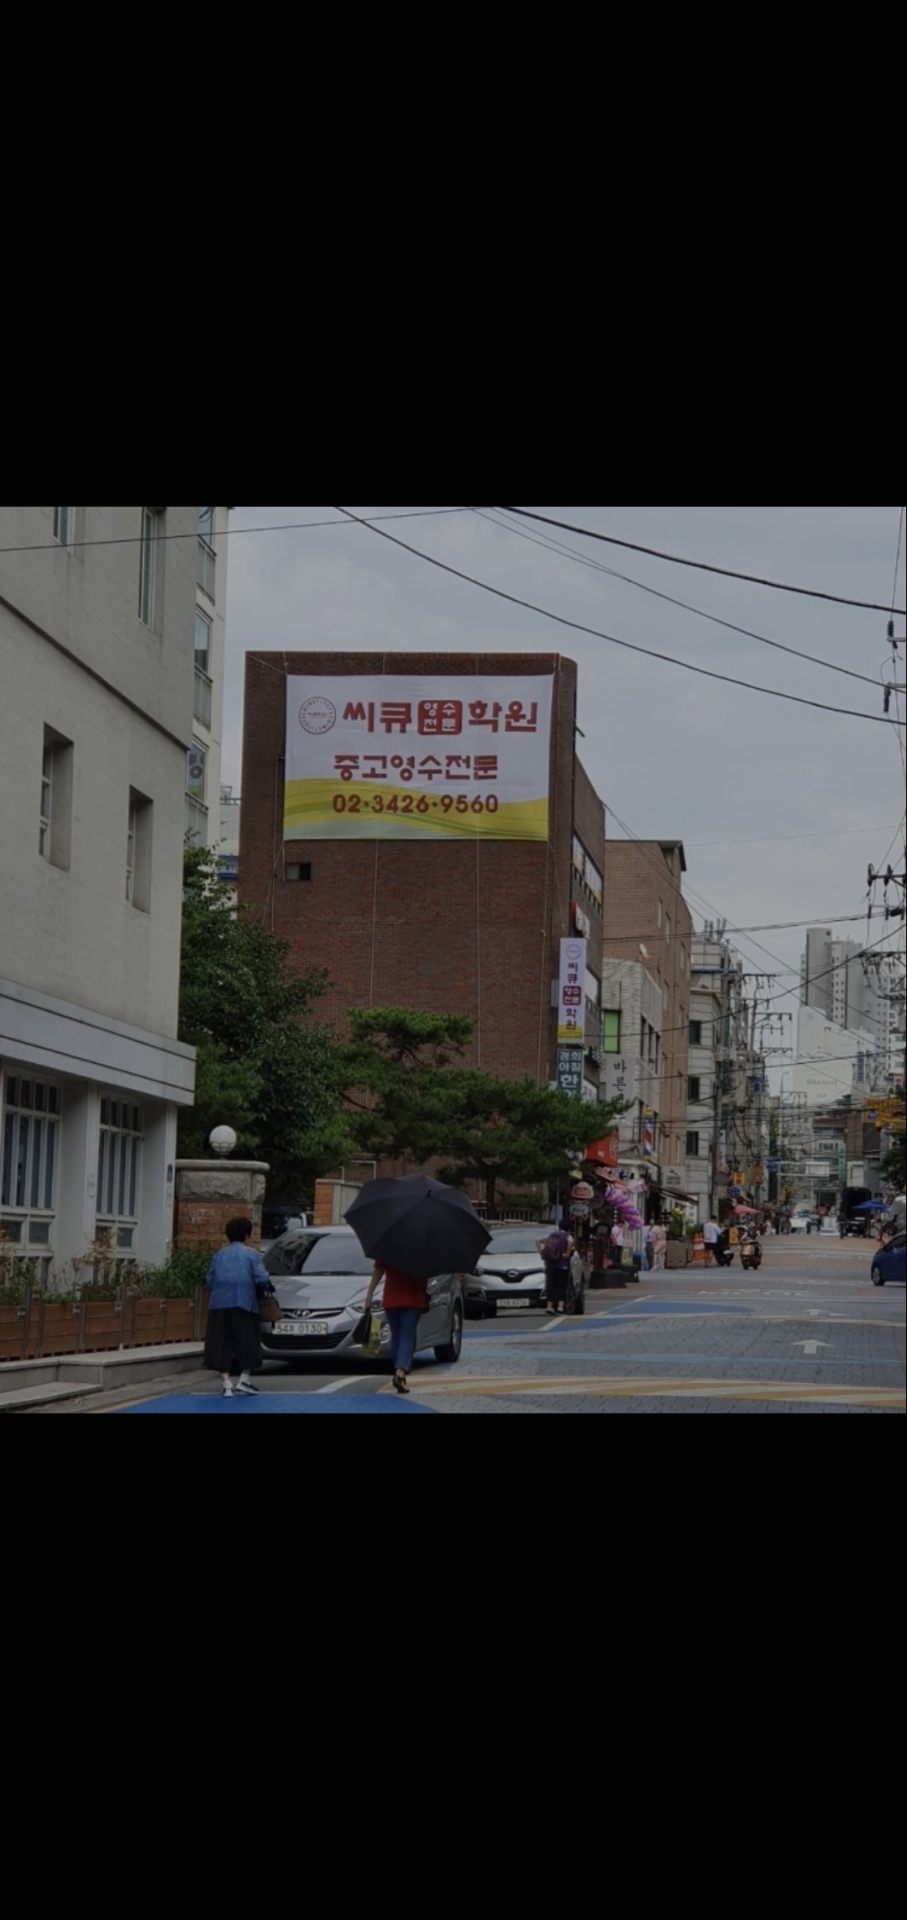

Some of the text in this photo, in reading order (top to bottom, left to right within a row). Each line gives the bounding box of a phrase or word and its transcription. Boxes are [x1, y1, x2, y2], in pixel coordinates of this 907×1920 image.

[342, 701, 413, 733] 씨큐
[423, 701, 457, 717] 영수
[468, 700, 538, 733] 학원
[423, 717, 457, 733] 전문
[333, 754, 498, 782] 중고영수전문
[567, 962, 578, 983] 씨큐
[566, 1008, 577, 1030] 학원
[559, 1062, 581, 1072] 아침
[298, 1324, 322, 1333] 0130
